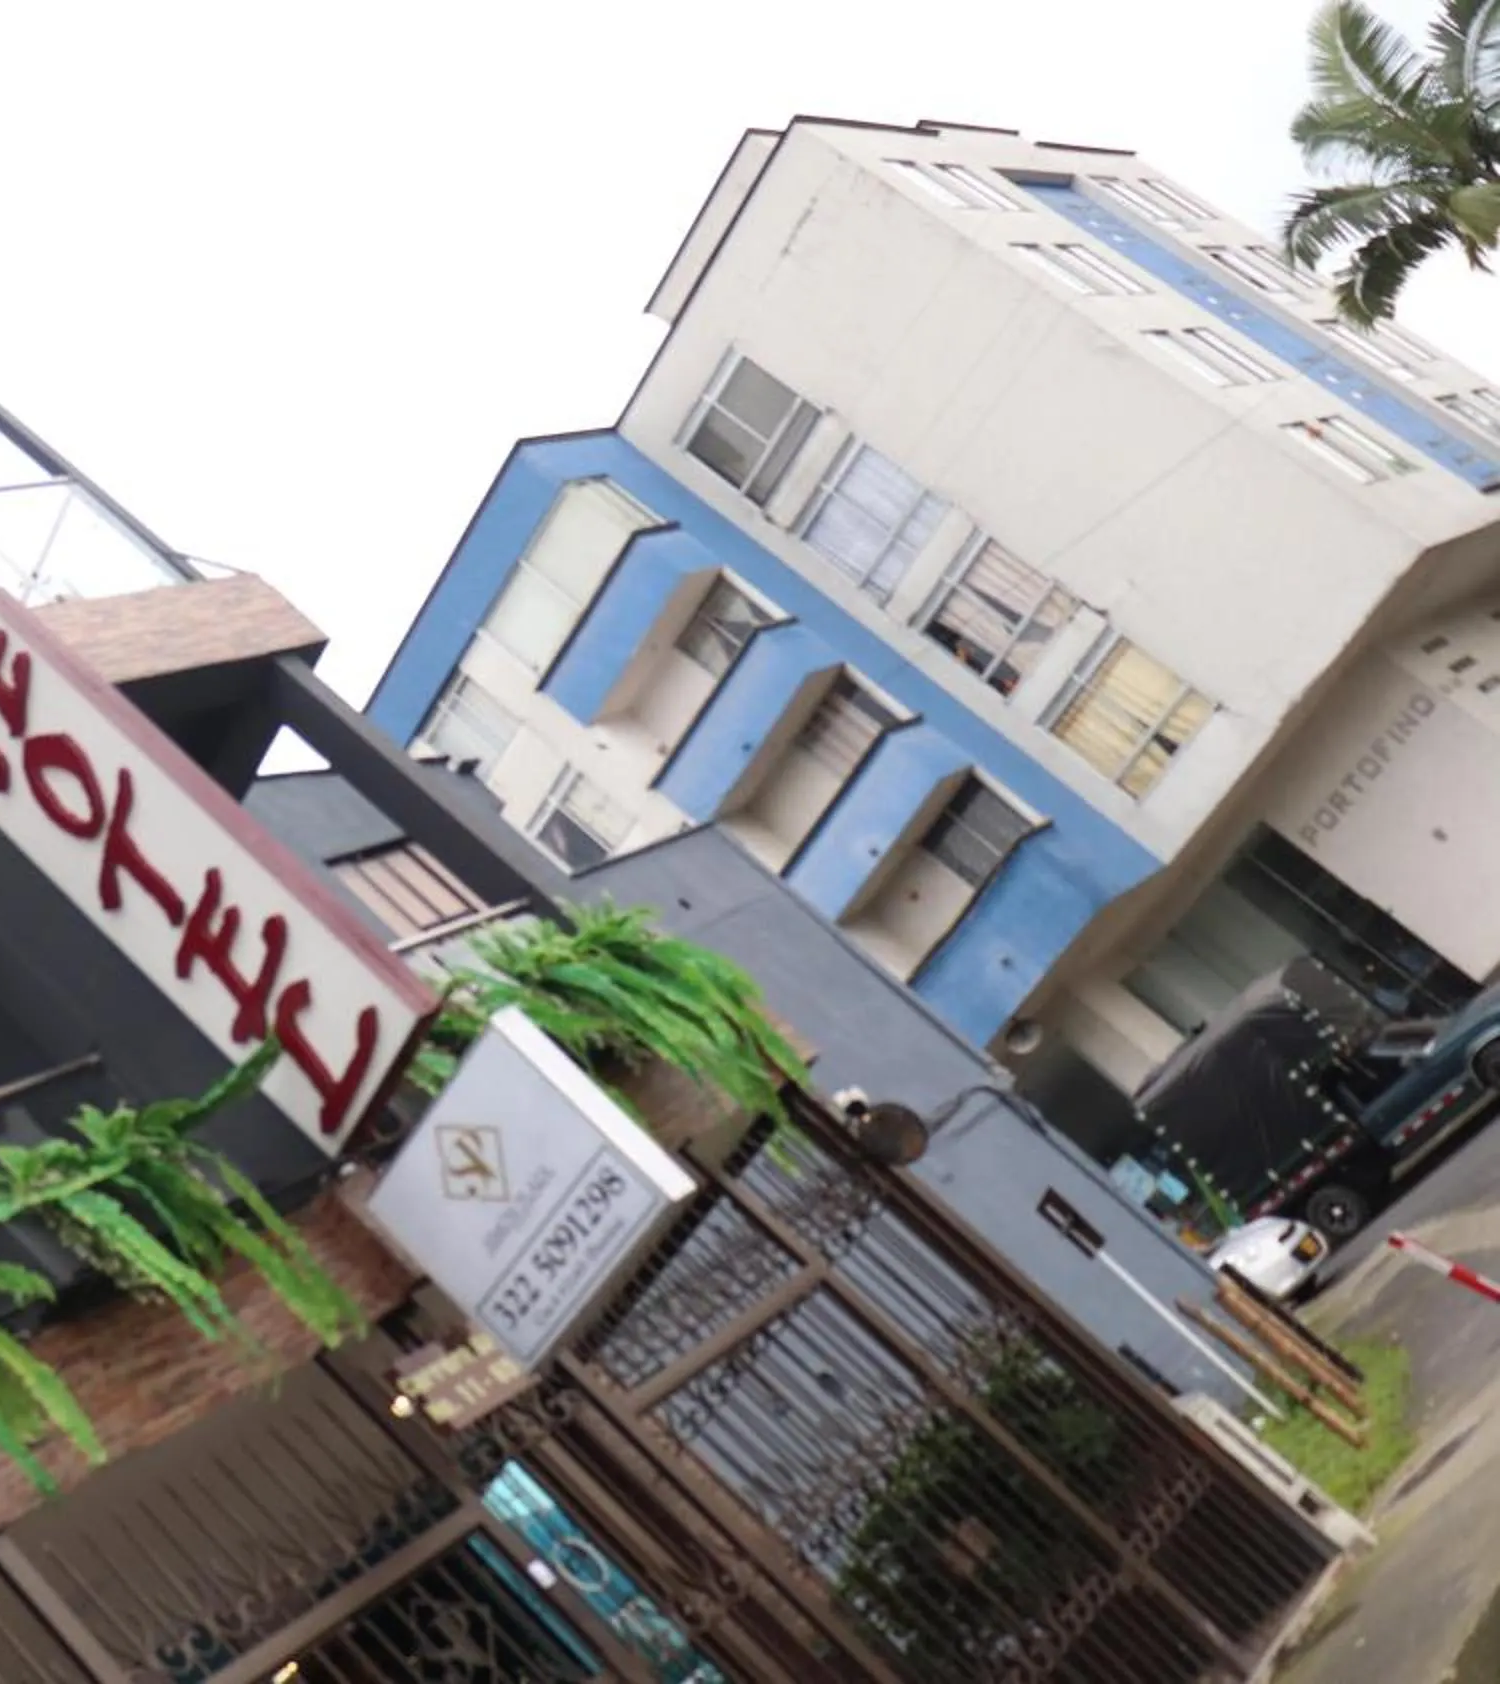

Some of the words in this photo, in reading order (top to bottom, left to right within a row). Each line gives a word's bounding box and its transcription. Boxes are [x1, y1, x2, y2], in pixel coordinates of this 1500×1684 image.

[1299, 692, 1436, 848] PORTOFINO
[492, 1274, 542, 1331] 322
[532, 1165, 628, 1283] 5091298
